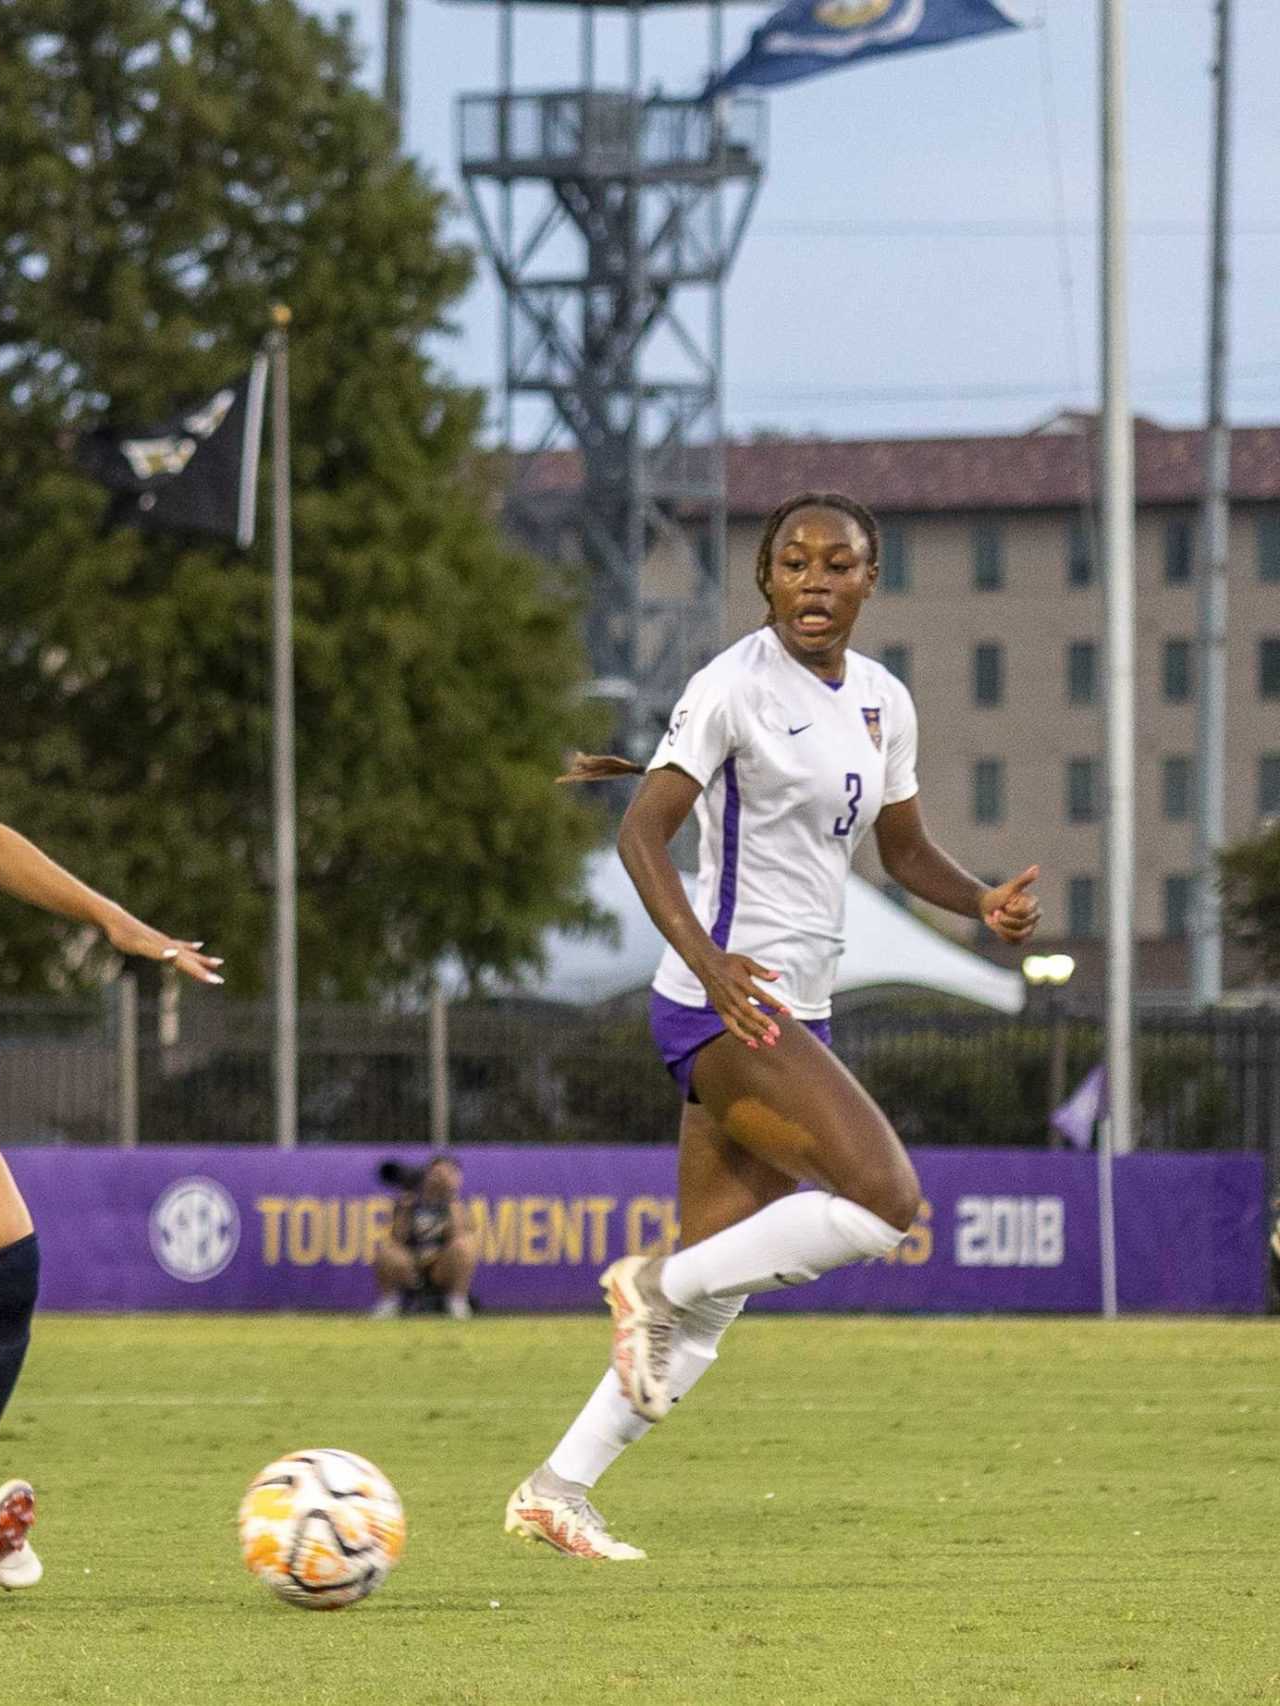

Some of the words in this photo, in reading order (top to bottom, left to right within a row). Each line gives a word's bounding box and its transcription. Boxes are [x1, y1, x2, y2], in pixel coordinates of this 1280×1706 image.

[833, 773, 862, 836] 3
[256, 1195, 618, 1267] TOURMENT
[954, 1196, 1065, 1267] 2018
